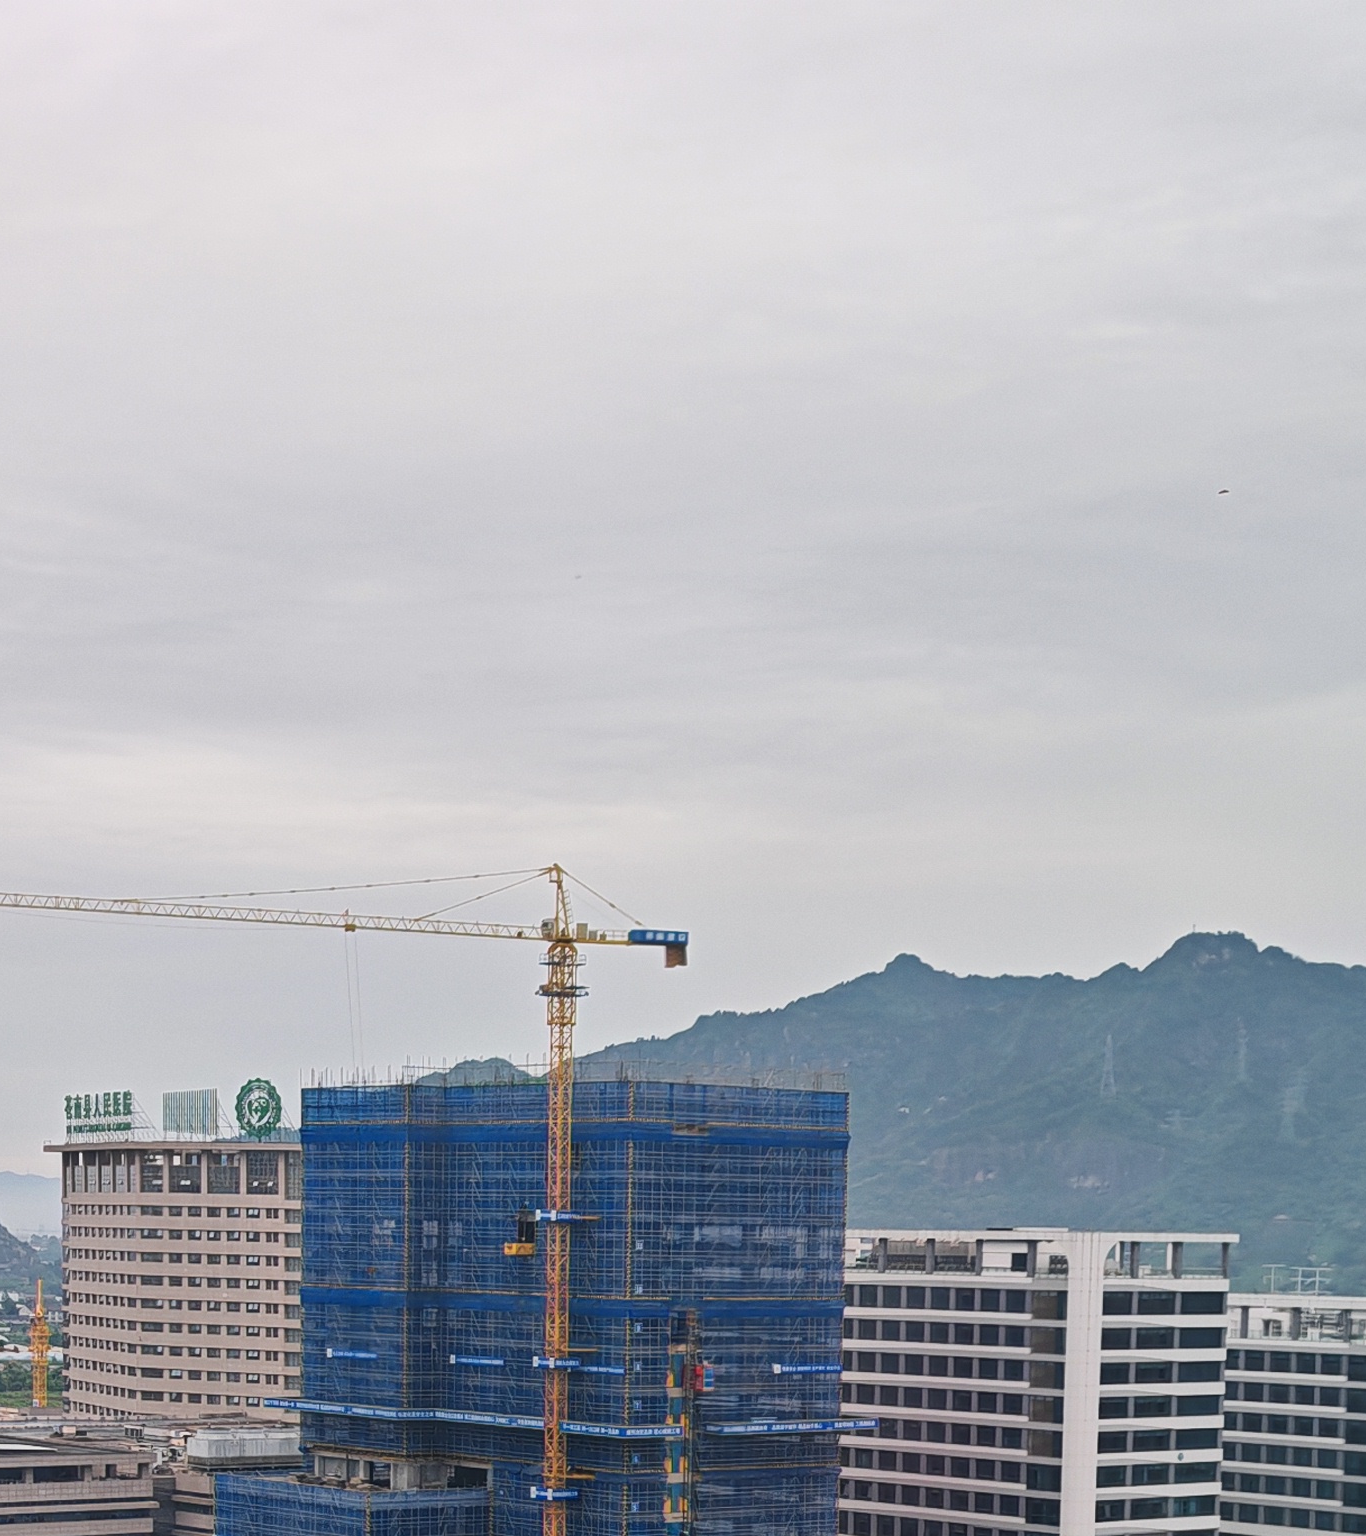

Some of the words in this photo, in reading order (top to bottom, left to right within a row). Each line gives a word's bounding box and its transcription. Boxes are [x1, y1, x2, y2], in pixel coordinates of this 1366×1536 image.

[64, 1090, 132, 1119] 苍南县人民医院
